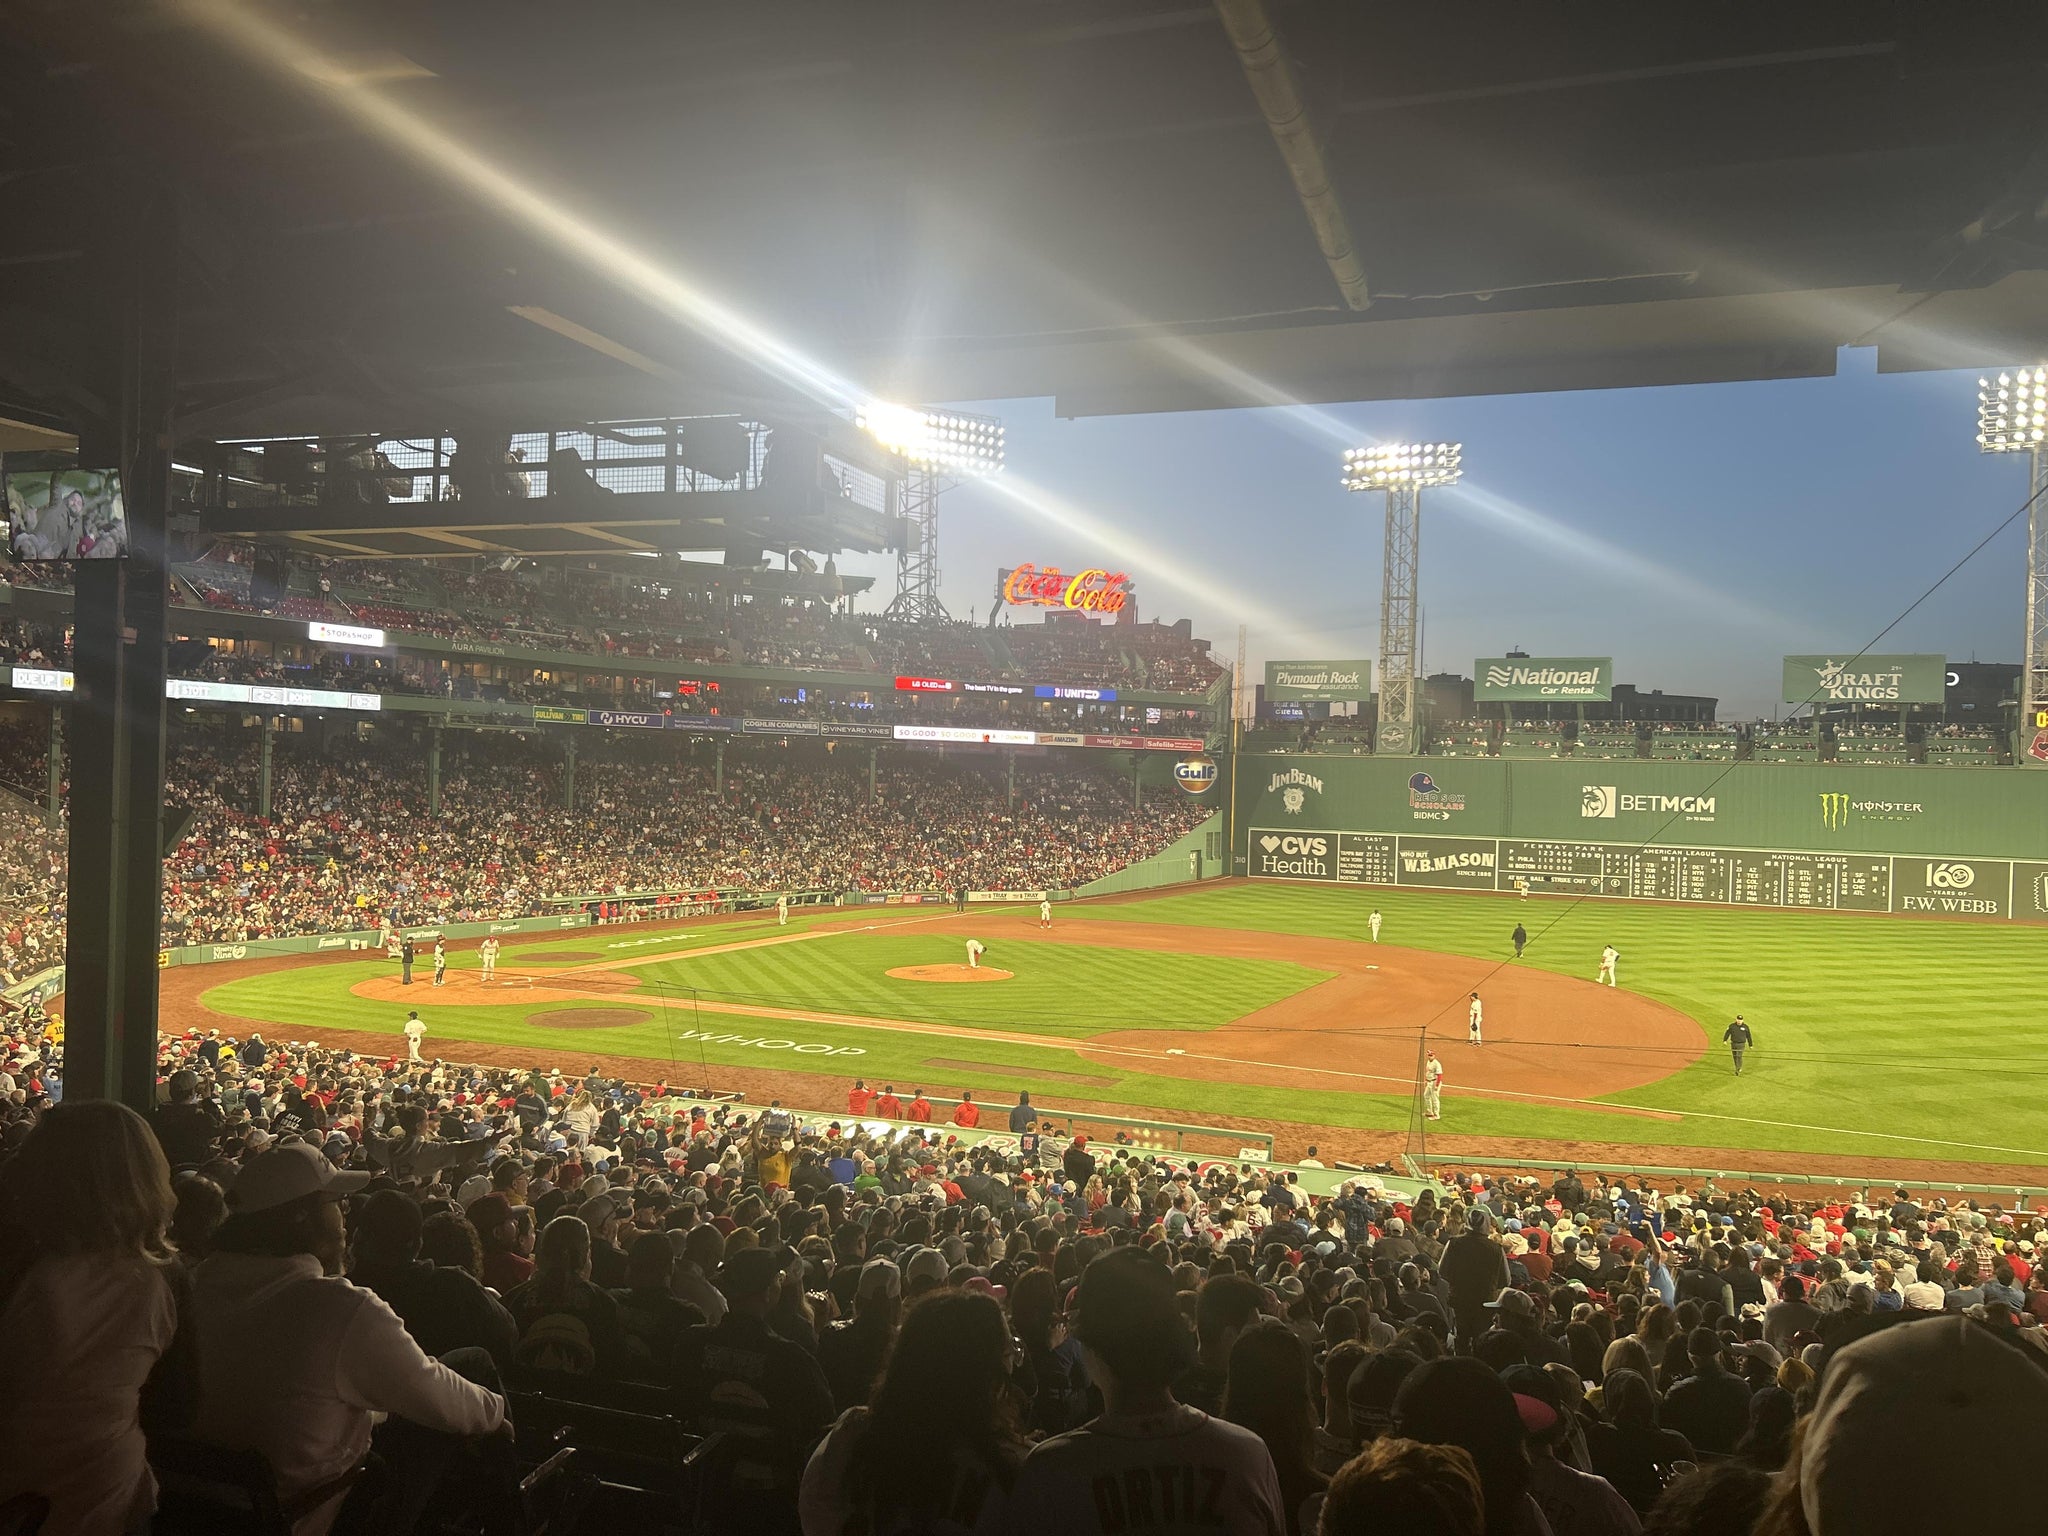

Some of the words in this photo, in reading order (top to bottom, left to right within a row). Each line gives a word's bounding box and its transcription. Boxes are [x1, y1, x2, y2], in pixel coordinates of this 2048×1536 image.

[17, 672, 38, 684] DUE
[40, 674, 53, 684] UP
[1276, 672, 1327, 685] Plymouth
[1330, 672, 1360, 684] Rock
[1820, 672, 1902, 689] DRAFT
[1540, 686, 1558, 694] Car
[1561, 686, 1594, 694] Rental
[1829, 686, 1899, 699] KINGS
[536, 709, 564, 720] SULLIVAN
[616, 714, 648, 724] HYCU
[744, 720, 776, 728] COGHLIN
[776, 722, 818, 730] COMPANIES
[1176, 765, 1215, 779] Gulf
[1415, 793, 1438, 802] RED
[1442, 794, 1465, 802] SOX
[1620, 795, 1716, 813] BETMGM
[1414, 802, 1465, 810] SCHOLARS
[1852, 800, 1923, 813] MONSTER
[1414, 812, 1440, 820] BIDMC
[1282, 836, 1327, 856] CVS
[1262, 855, 1327, 876] Health
[1926, 863, 1975, 888] 160
[1903, 896, 1936, 911] F.W.
[1940, 898, 1998, 914] WEBB
[678, 1030, 867, 1056] WHOOP
[1091, 1464, 1229, 1534] ORTIZ
